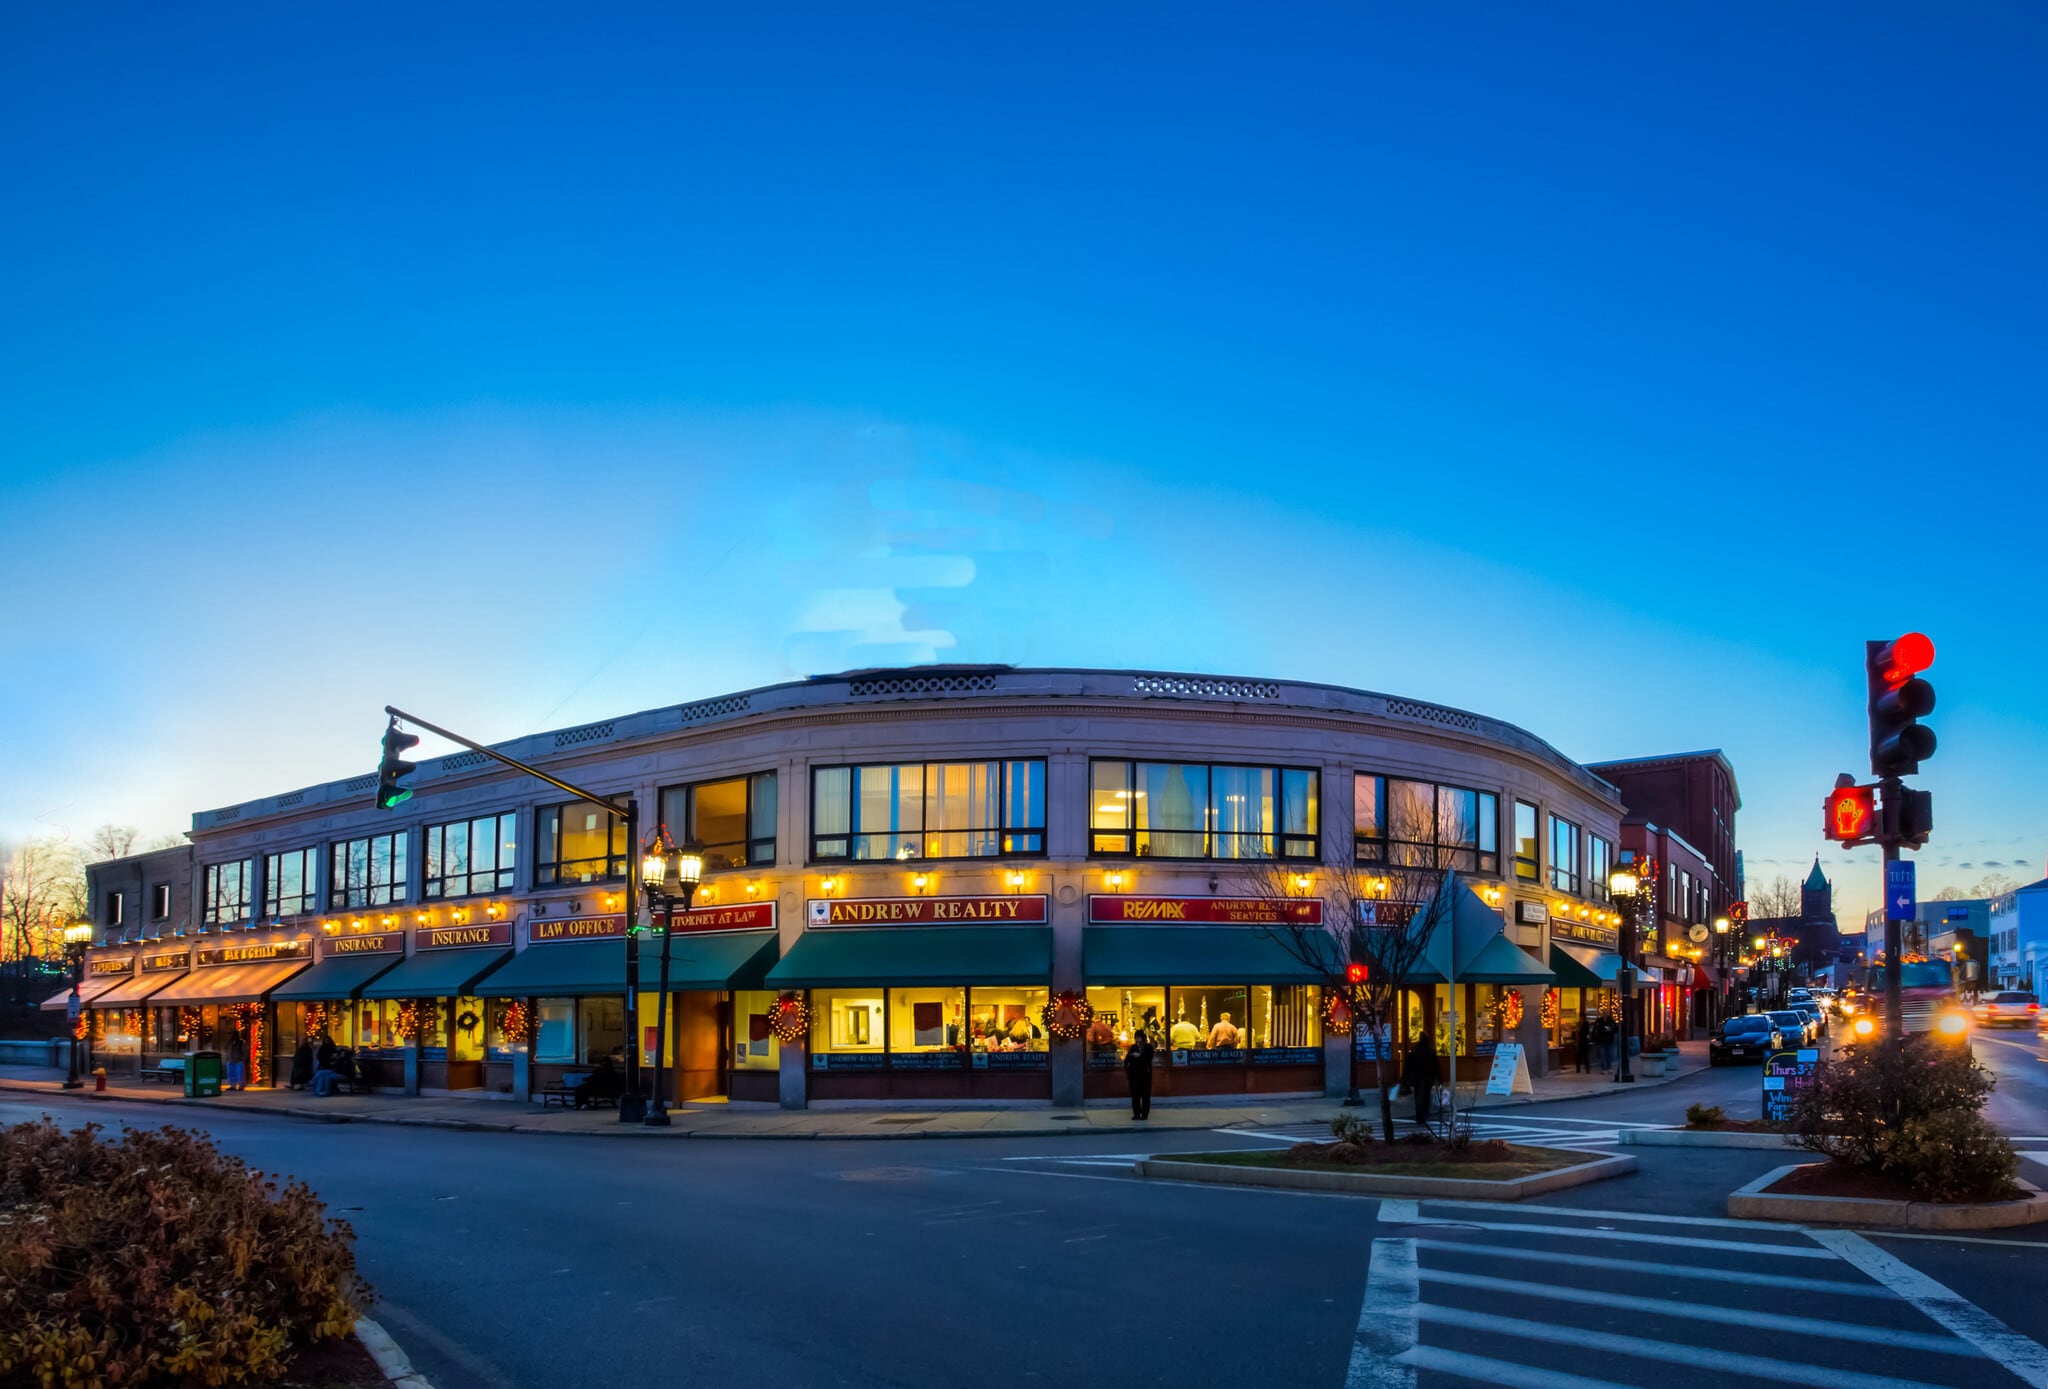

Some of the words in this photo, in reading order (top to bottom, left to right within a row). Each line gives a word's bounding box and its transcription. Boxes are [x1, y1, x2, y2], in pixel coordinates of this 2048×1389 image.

[831, 904, 924, 921] ANDREW
[933, 901, 1021, 919] REALTY
[1123, 900, 1186, 919] RE/MAX
[1210, 901, 1255, 910] ANDREW
[1258, 902, 1295, 911] RETY
[671, 913, 716, 927] TTORNEY
[718, 912, 732, 924] AT
[734, 910, 757, 923] LAW
[1229, 911, 1277, 921] SERVICES
[431, 928, 490, 946] INSURANCE
[539, 922, 565, 938] LAW
[569, 919, 615, 935] OFFICE
[335, 937, 384, 952] INSURANCE
[1770, 1062, 1796, 1075] Thurs
